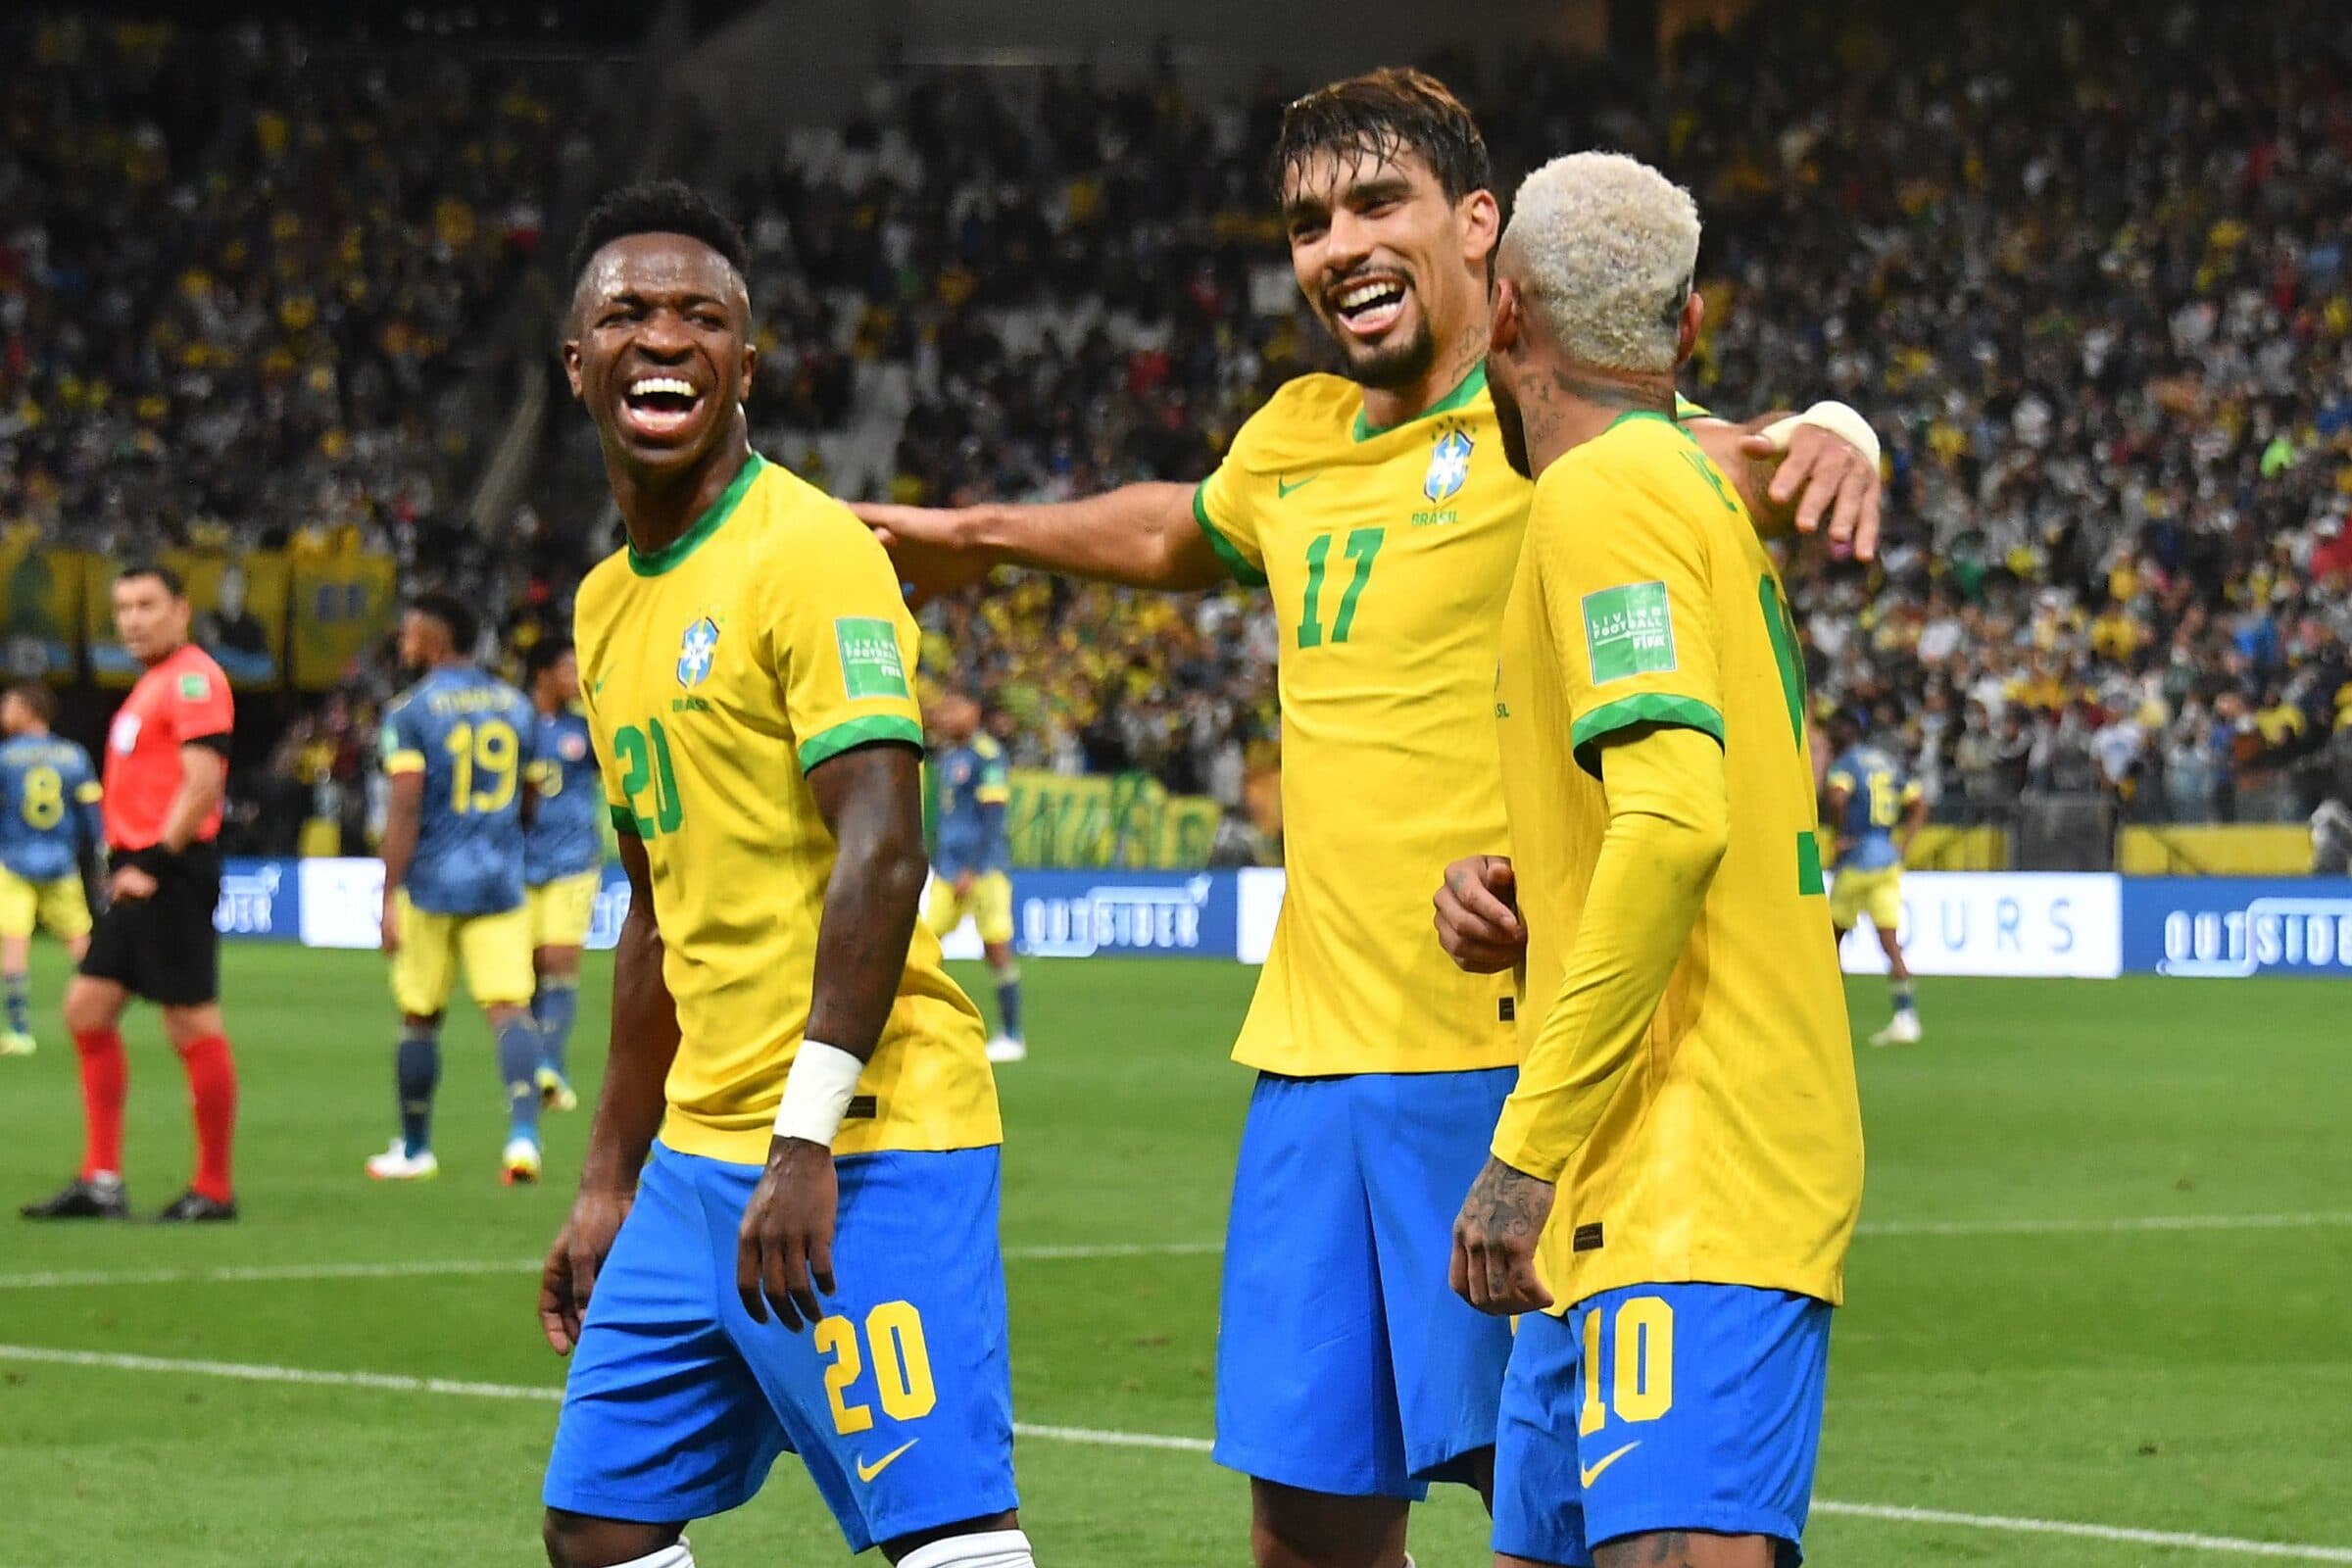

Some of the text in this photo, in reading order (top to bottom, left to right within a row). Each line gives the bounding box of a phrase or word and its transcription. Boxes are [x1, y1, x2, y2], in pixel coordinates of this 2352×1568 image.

[1411, 510, 1459, 526] BRASIL
[1298, 527, 1385, 649] 17
[1592, 607, 1663, 630] LIVING
[1593, 615, 1663, 640] FOOTBALL
[1633, 635, 1665, 650] FIFA
[22, 766, 65, 831] 8
[444, 721, 518, 814] 19
[614, 717, 682, 840] 20
[1020, 890, 1201, 953] OUTSIDER
[813, 1300, 936, 1435] 20
[1580, 1296, 1673, 1436] 10
